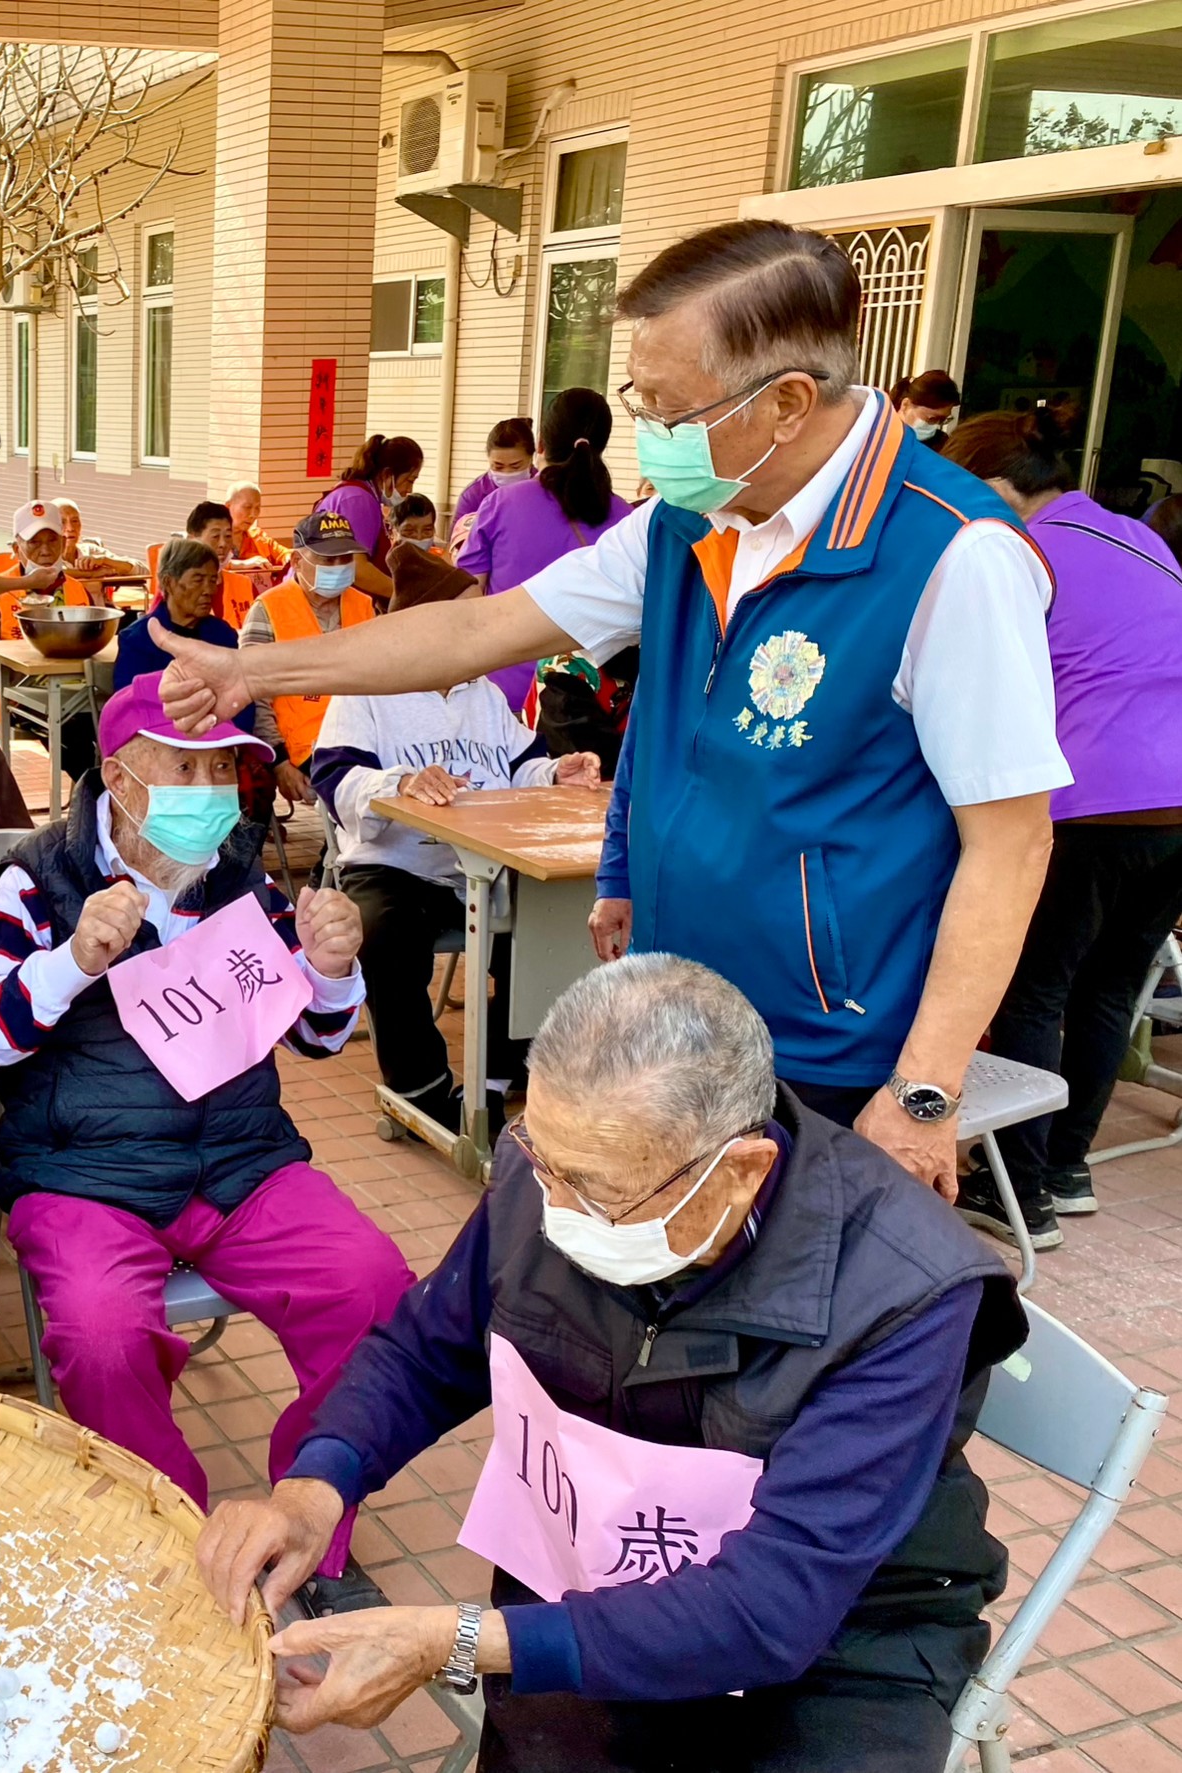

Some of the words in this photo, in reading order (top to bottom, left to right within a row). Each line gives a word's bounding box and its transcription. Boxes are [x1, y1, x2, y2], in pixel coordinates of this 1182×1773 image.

[137, 975, 227, 1043] 101
[226, 949, 284, 1004] 歲
[603, 1505, 699, 1587] 歲
